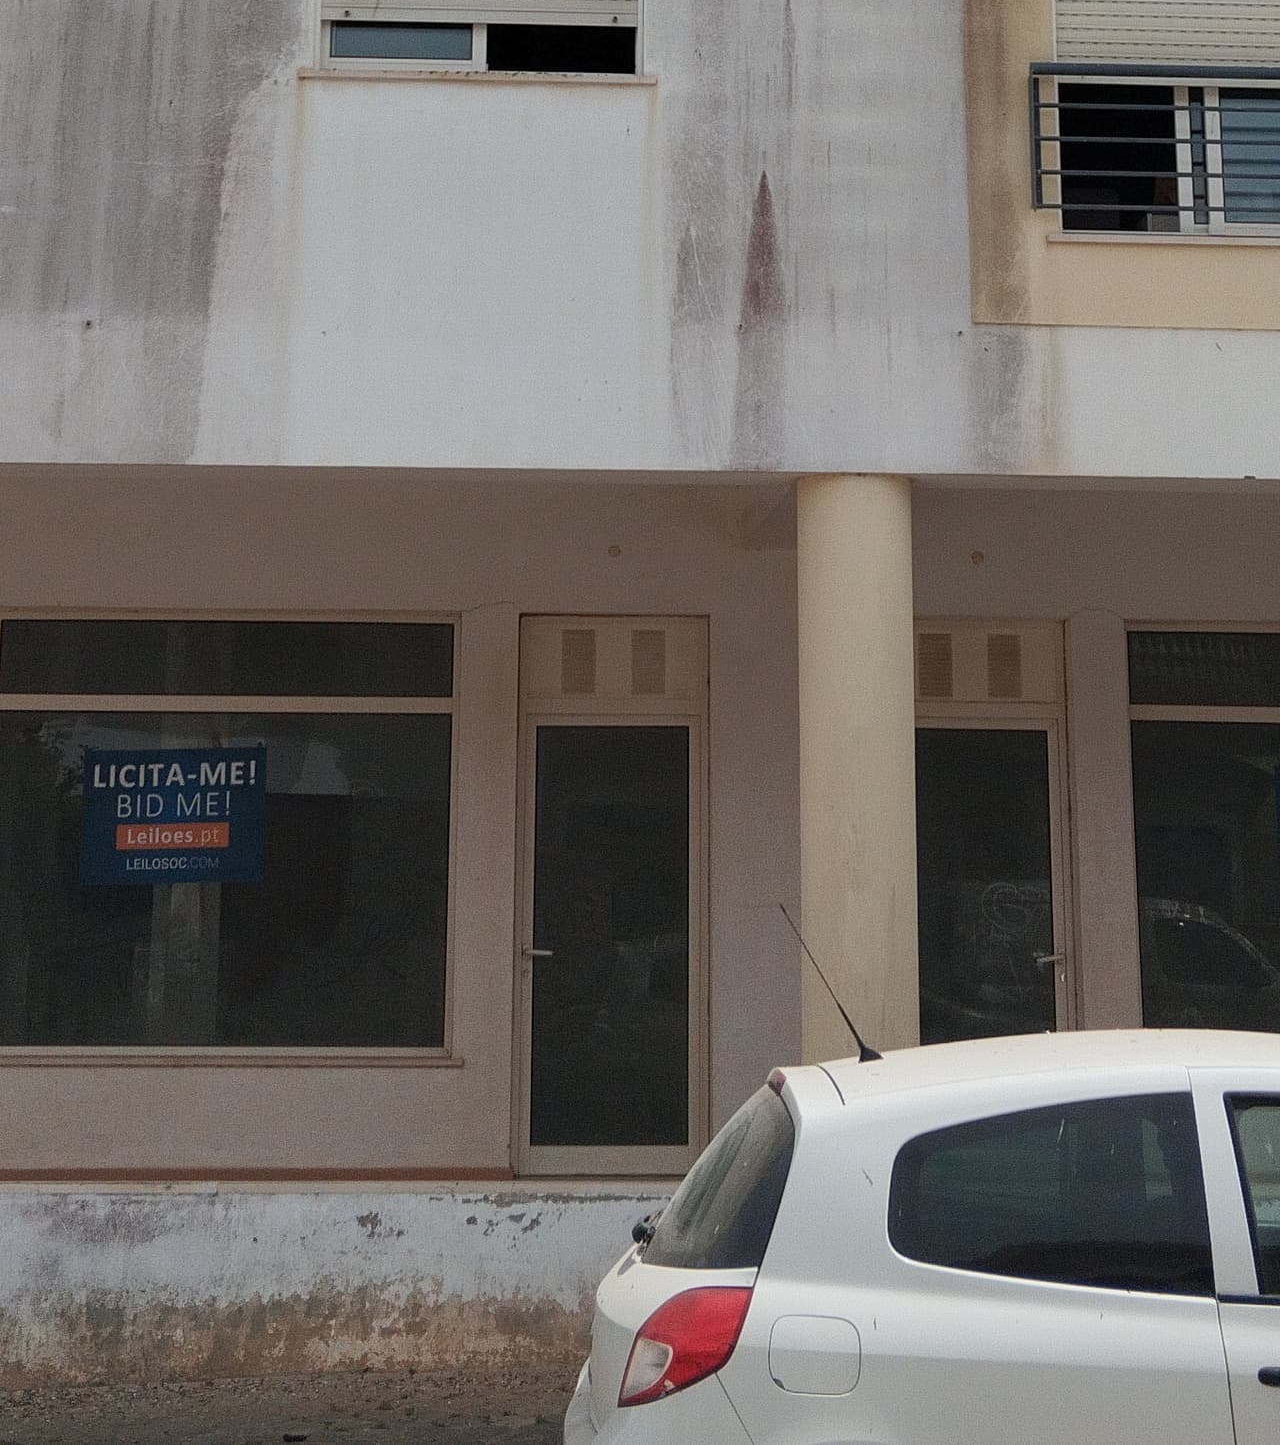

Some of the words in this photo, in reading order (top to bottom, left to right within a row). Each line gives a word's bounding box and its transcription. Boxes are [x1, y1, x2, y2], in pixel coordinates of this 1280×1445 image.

[93, 760, 257, 788] LICITA-ME!
[116, 793, 164, 818] BID
[176, 790, 231, 817] ME!
[126, 826, 220, 847] Leiloes.pt
